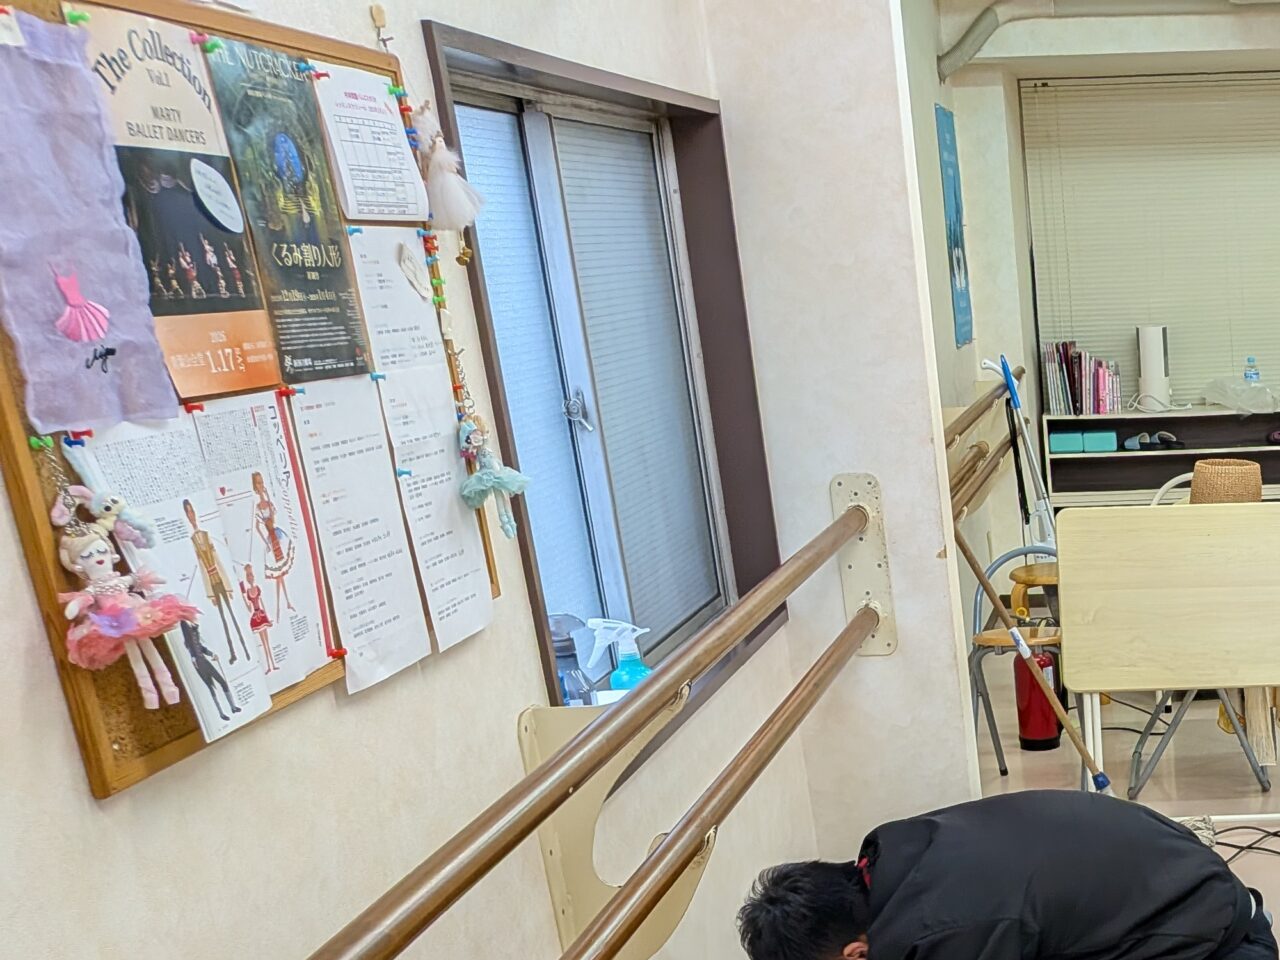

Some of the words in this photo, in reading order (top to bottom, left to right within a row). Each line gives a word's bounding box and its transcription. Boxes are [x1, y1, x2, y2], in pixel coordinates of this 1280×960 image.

[93, 48, 132, 95] The
[128, 28, 212, 112] Collection
[126, 121, 164, 140] BALLET
[167, 126, 207, 145] DANCERS
[271, 242, 342, 268] くるみ割り人形
[204, 347, 236, 373] 1.17
[268, 405, 291, 488] コッペリア
